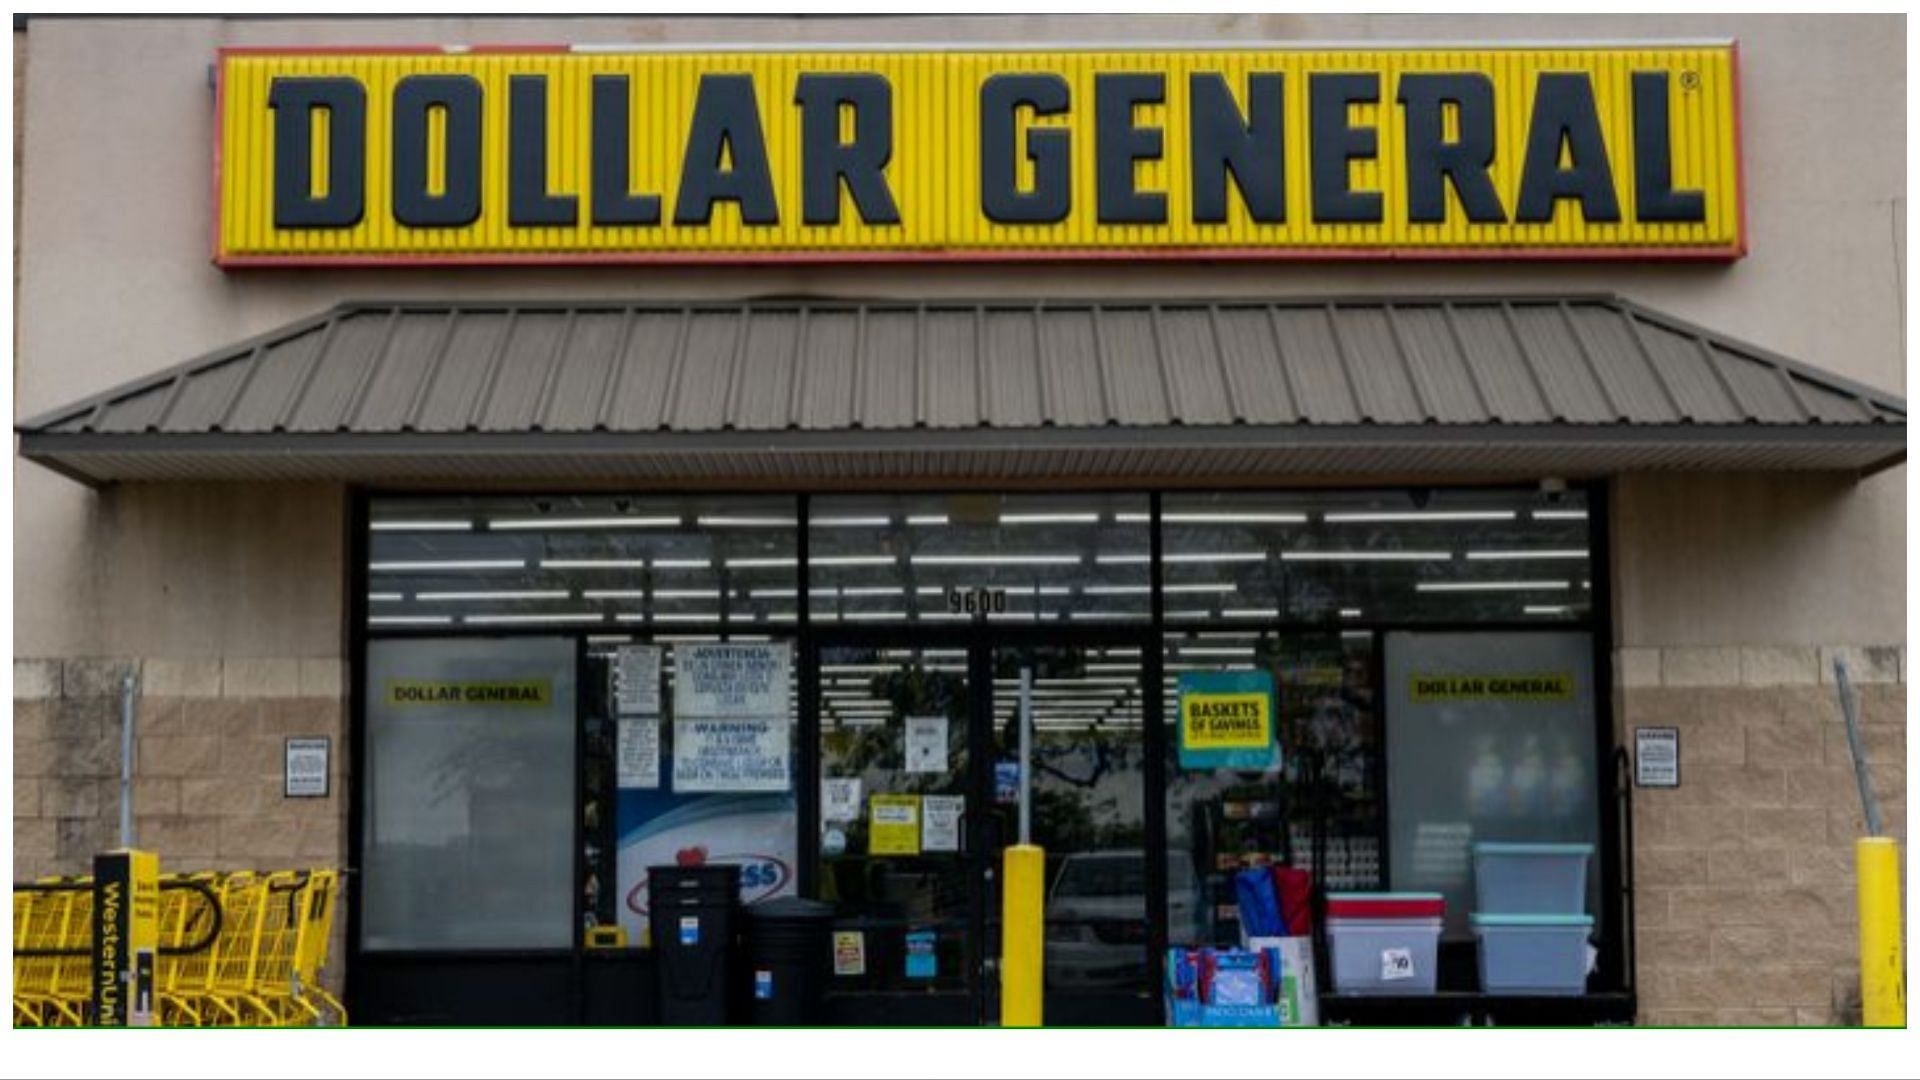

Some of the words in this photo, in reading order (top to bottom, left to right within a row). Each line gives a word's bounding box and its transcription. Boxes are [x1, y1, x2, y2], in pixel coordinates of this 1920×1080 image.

[268, 73, 902, 230] DOLLAR
[978, 71, 1706, 227] GENERAL
[950, 589, 1006, 613] 9600
[394, 686, 461, 701] DOLLAR
[464, 686, 542, 701] GENERAL
[1417, 679, 1484, 696] DOLLAR
[1488, 678, 1566, 694] GENERAL
[1189, 702, 1260, 717] BASKETS
[695, 723, 768, 734] WARNING
[1190, 718, 1207, 732] OF
[1211, 718, 1261, 731] SAVINGS
